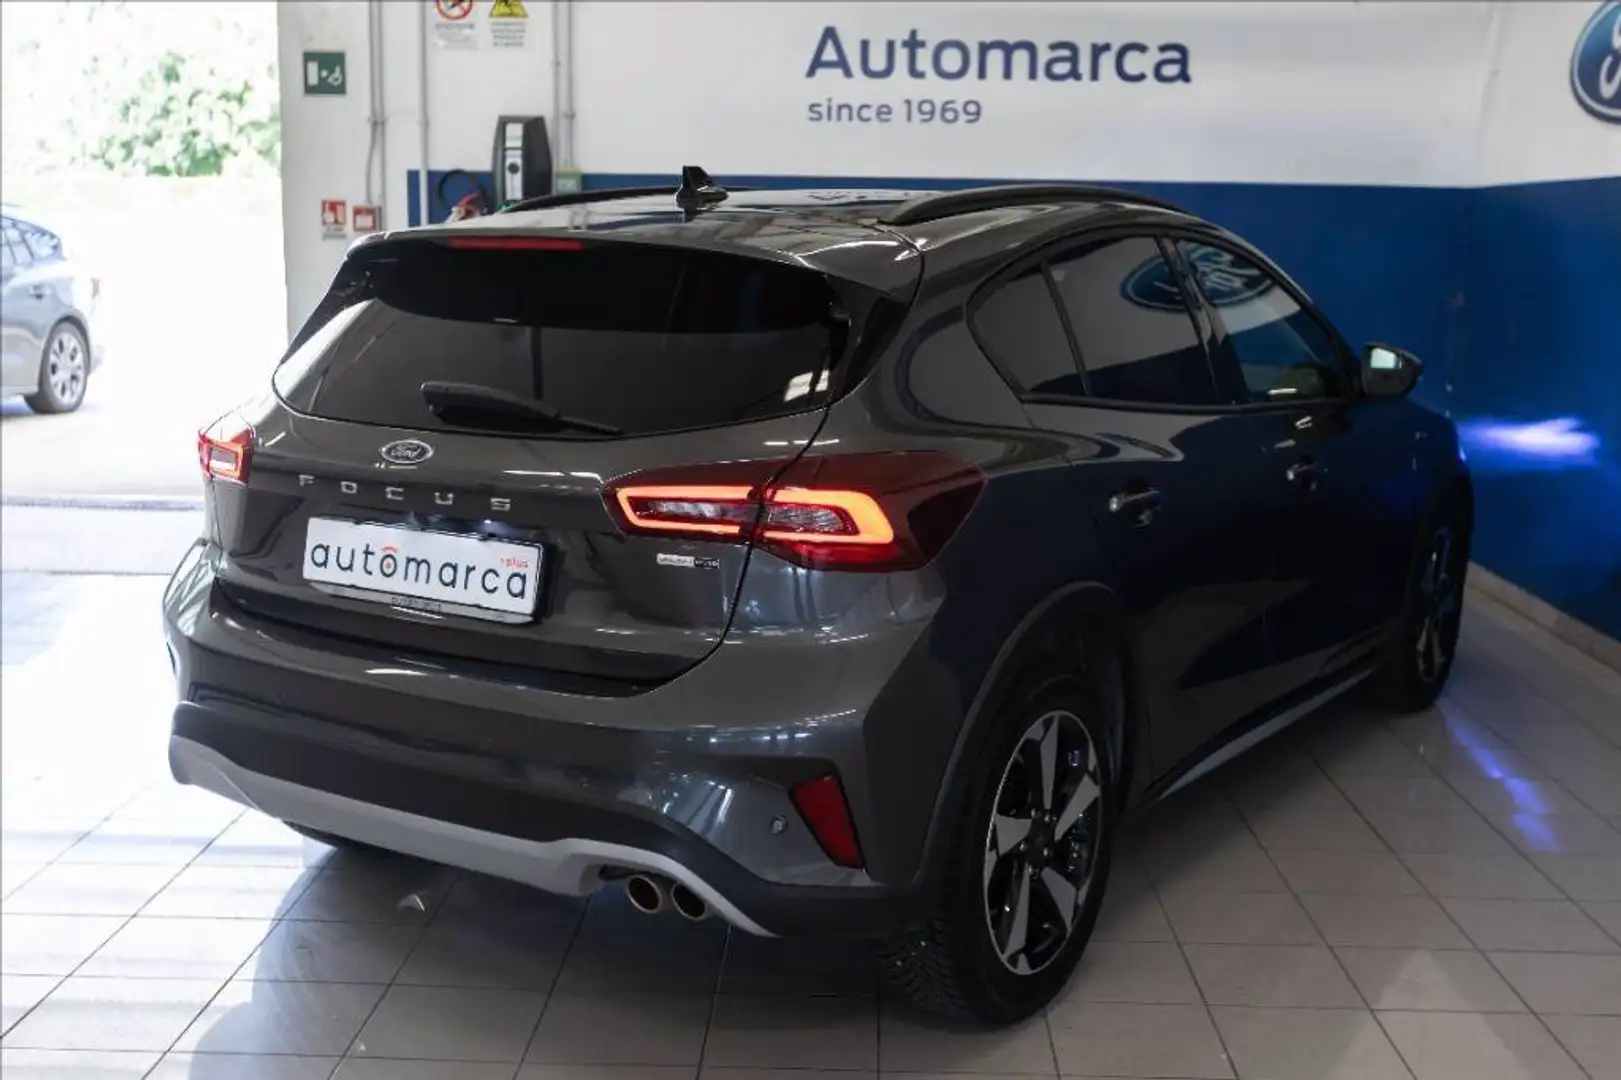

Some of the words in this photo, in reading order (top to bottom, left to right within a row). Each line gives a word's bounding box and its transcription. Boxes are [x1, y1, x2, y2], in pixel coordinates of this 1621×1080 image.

[805, 26, 1192, 84] Automarca
[807, 98, 893, 123] since
[904, 99, 982, 124] 1969
[299, 474, 511, 511] FOCUS
[311, 543, 527, 600] automarca
